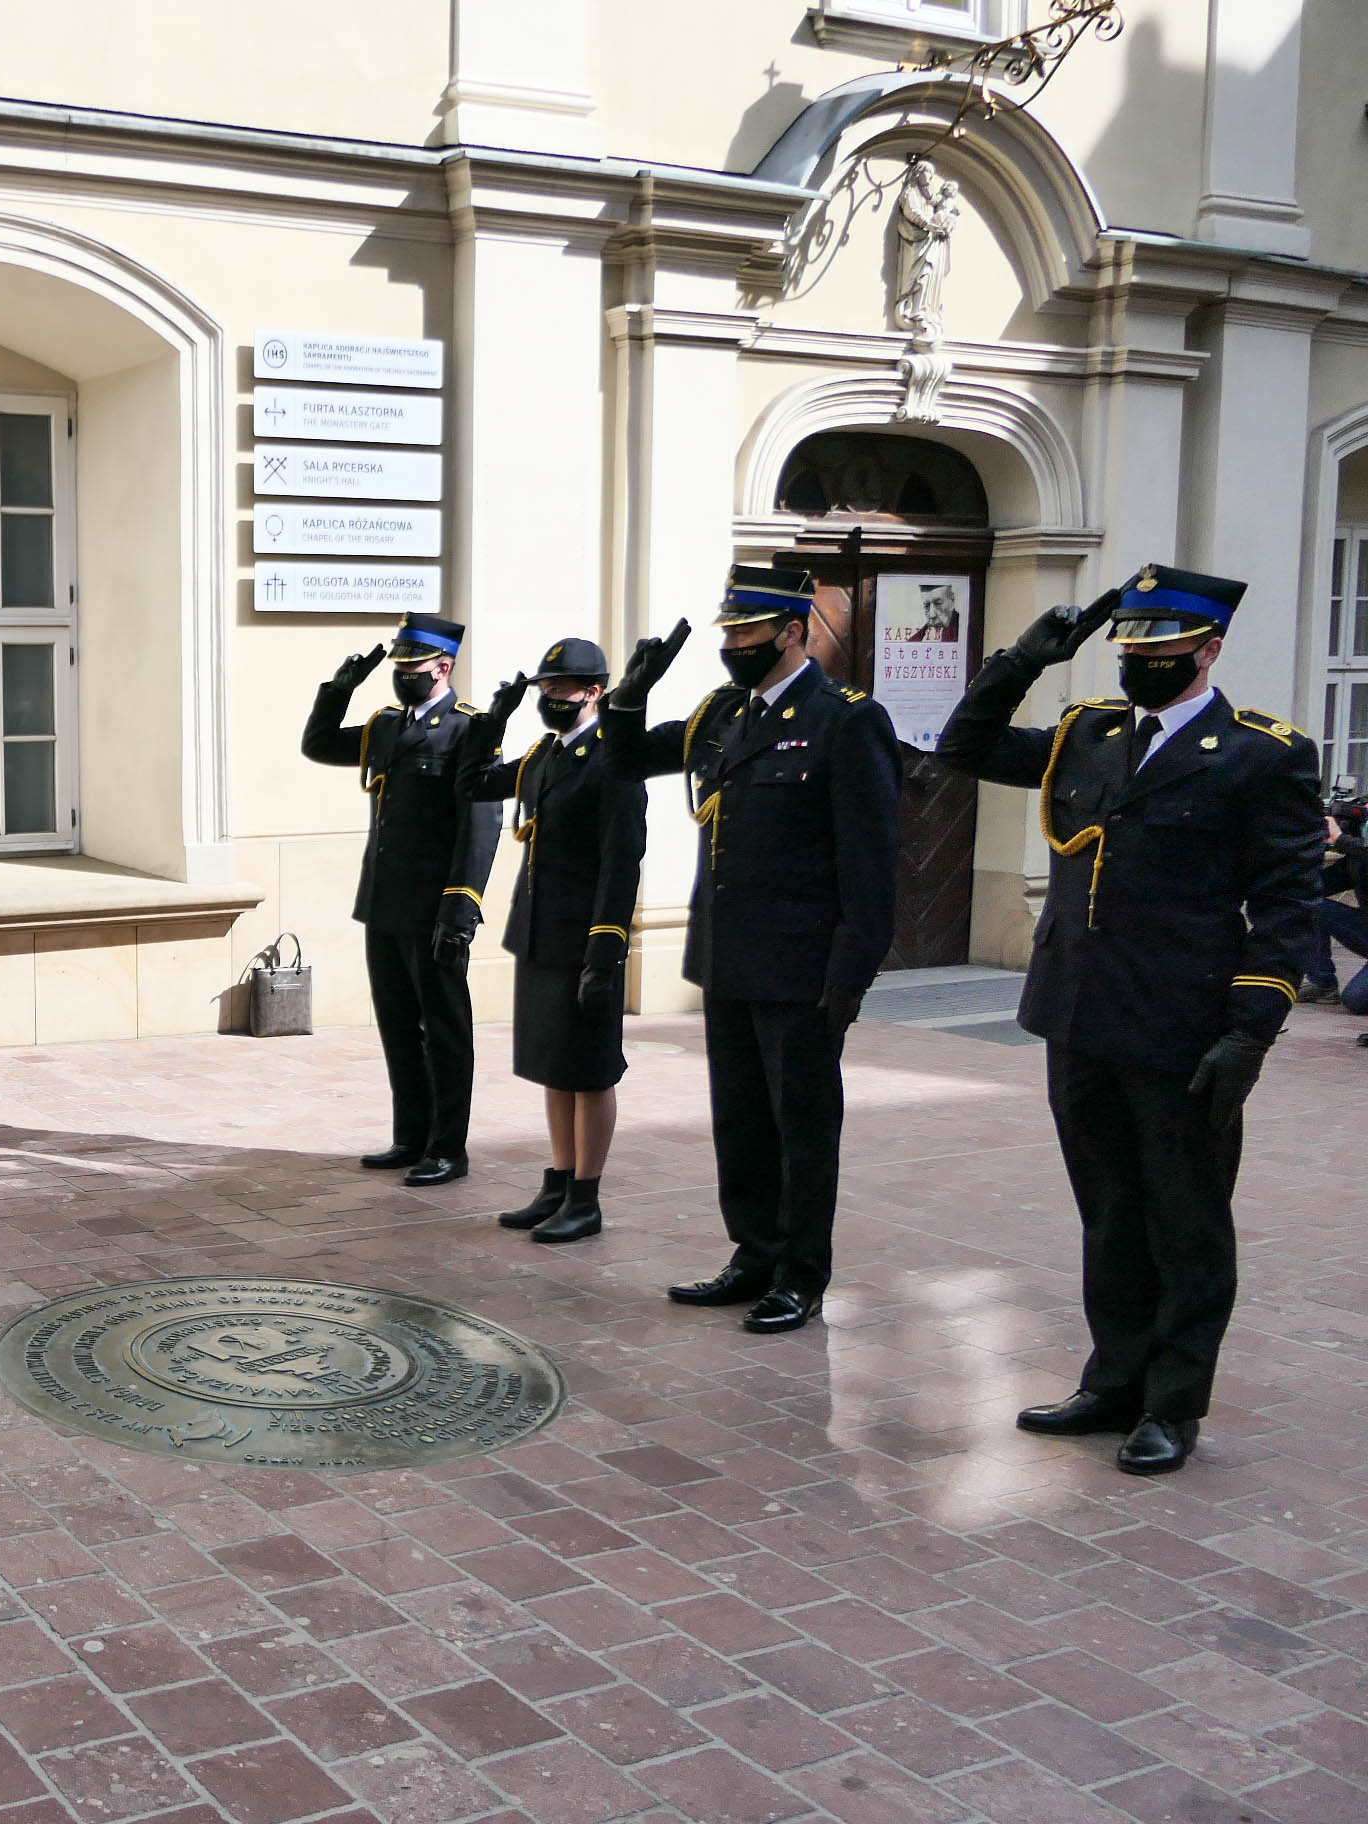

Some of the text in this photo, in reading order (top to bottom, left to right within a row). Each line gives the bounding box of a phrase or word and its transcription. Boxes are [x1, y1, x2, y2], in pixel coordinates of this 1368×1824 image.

[267, 349, 285, 360] IHS
[303, 342, 333, 351] KAPLICA
[335, 345, 371, 354] ADORACJI
[303, 351, 352, 361] SAKRAMENTU
[303, 403, 405, 418] FURTA KLASZTORNA
[303, 418, 391, 430] THE MONASTERY GATE
[303, 460, 384, 474] SALA RYCERSKA
[302, 517, 412, 531] KAPLICA RÓŻAŃCOWA
[302, 533, 395, 545] CHAPEL OF THE ROSARY
[303, 575, 425, 589] GOLGOTA JASNOGÓRSKA
[303, 591, 423, 602] THE GOLGOTHA OF JASNA GÓRA
[884, 647, 959, 660] Stefan
[884, 664, 957, 679] WYSZYŃSKI
[217, 1296, 242, 1304] OD
[255, 1295, 307, 1306] ROKU
[102, 1308, 145, 1325] GÓRY
[105, 1385, 167, 1411] DRUGA
[369, 1406, 477, 1440] Gospodarki
[418, 1414, 491, 1446] Ochrony
